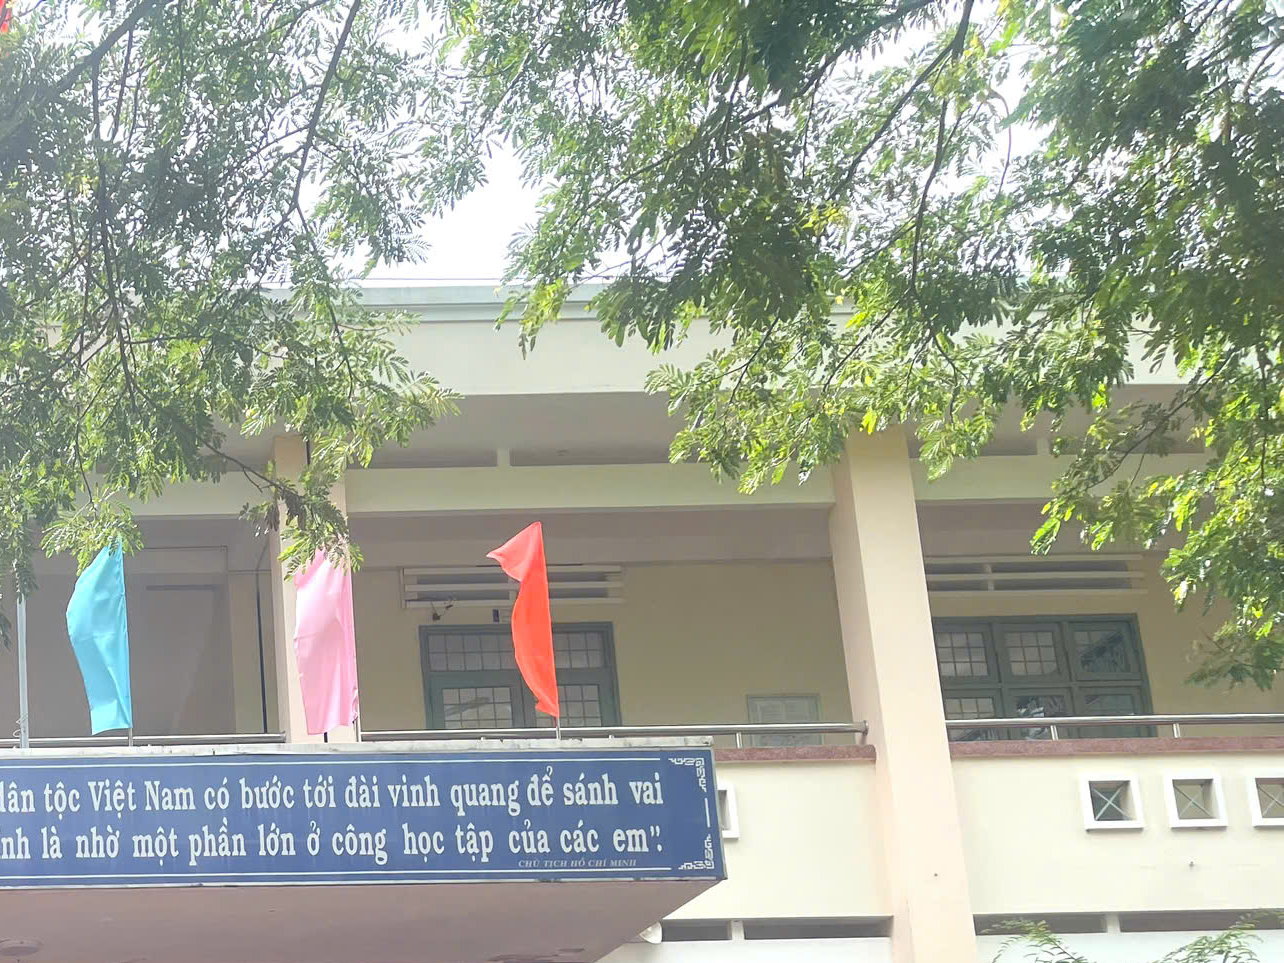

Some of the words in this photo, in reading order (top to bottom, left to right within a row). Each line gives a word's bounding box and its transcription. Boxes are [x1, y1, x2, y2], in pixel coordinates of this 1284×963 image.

[43, 780, 81, 821] tộc
[87, 778, 137, 820] Việt
[143, 780, 197, 811] Nam
[203, 776, 230, 811] có
[238, 774, 295, 809] bước
[302, 774, 337, 809] tới
[344, 774, 381, 808] đài
[387, 774, 441, 808] vinh
[450, 779, 521, 817] quang
[526, 765, 554, 806] để
[562, 772, 619, 806] sánh
[628, 771, 664, 805] vai
[40, 825, 63, 860] là
[75, 824, 121, 859] nhờ
[131, 825, 180, 867] một
[187, 816, 247, 867] phần
[257, 822, 296, 857] lớn
[306, 820, 321, 856] ở
[331, 823, 388, 866] công
[401, 822, 445, 863] học
[454, 822, 494, 863] tập
[508, 818, 551, 854] của
[559, 819, 600, 854] các
[610, 859, 637, 867] MINH
